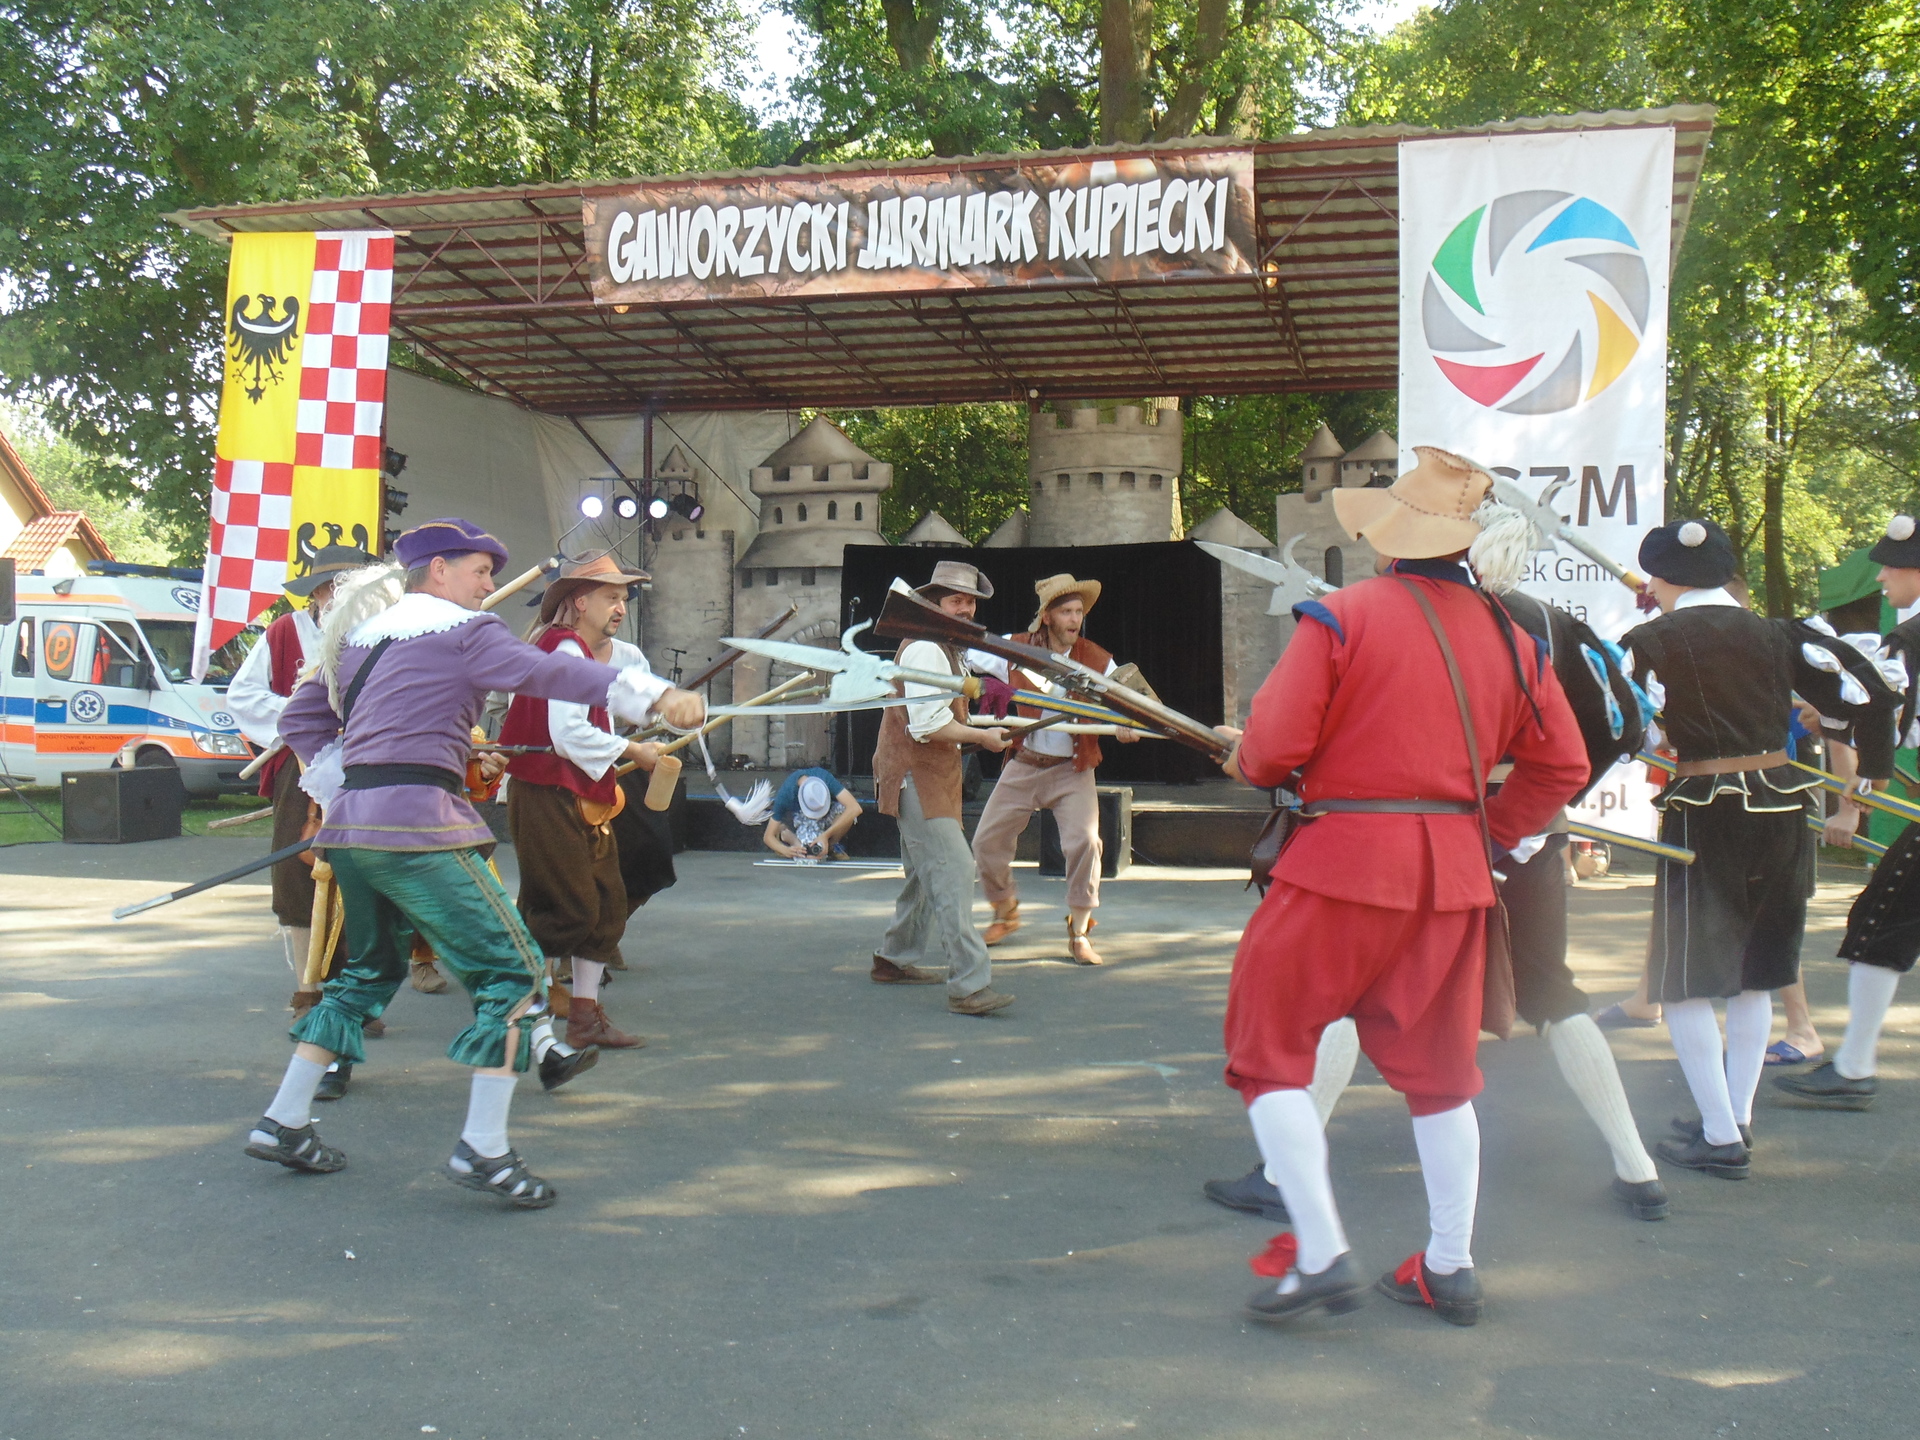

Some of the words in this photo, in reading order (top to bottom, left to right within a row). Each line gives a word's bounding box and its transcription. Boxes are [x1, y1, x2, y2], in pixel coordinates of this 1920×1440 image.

[607, 201, 849, 283] GAWORZYCKI
[859, 190, 1038, 271] JARMARK
[1047, 177, 1228, 260] KUPIECKI
[1490, 464, 1638, 527] ZM
